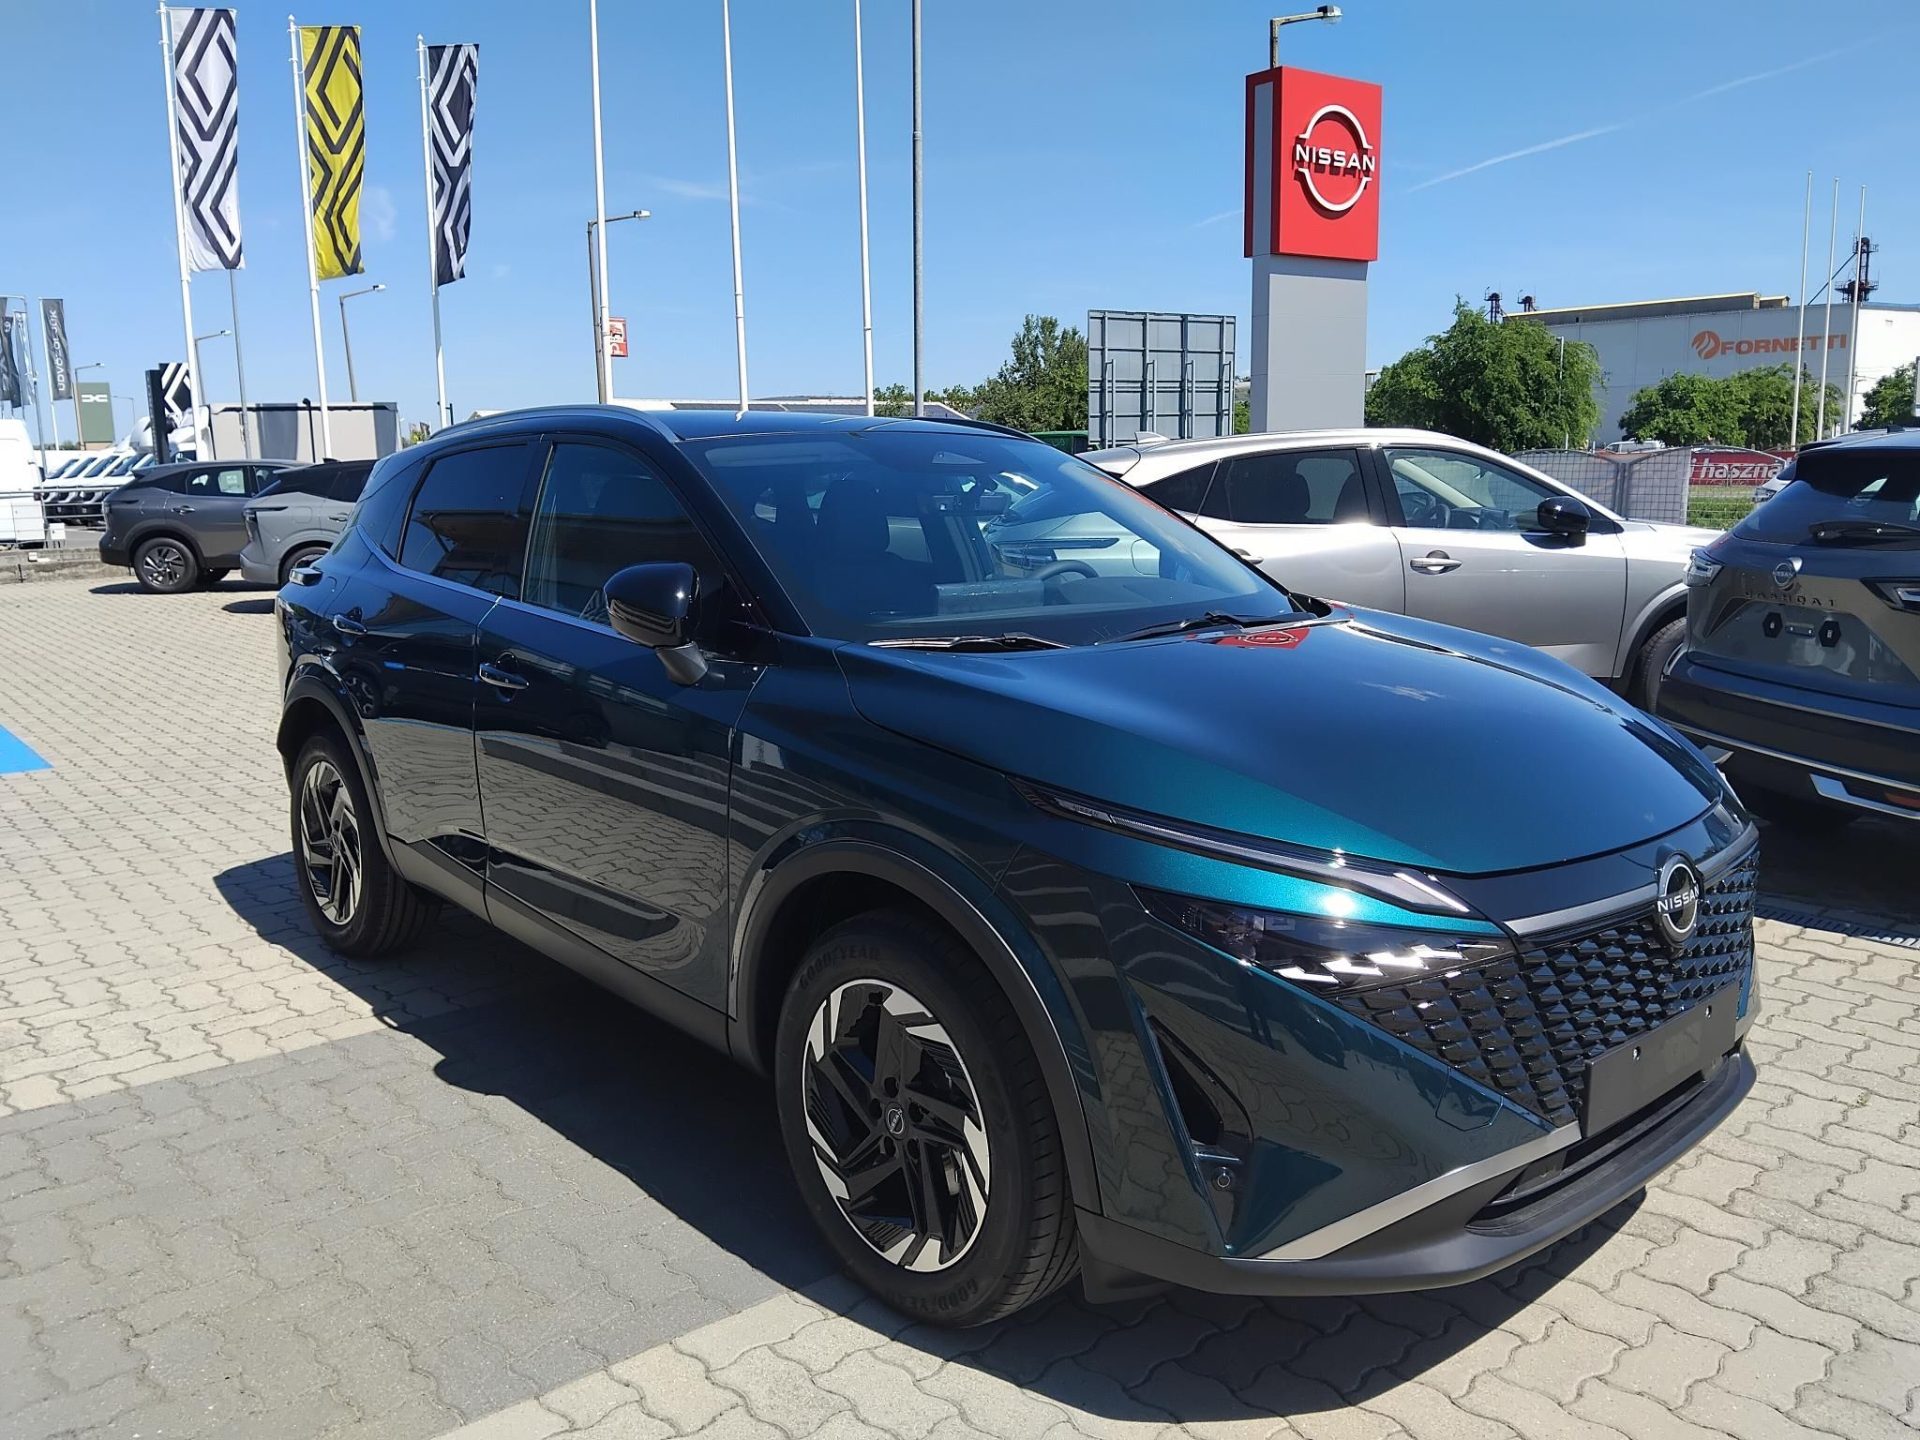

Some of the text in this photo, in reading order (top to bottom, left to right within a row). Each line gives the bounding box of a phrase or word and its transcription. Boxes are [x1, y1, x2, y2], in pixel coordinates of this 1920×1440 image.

[1295, 144, 1376, 172] NISSAN
[1720, 333, 1848, 355] FORNETTI
[1657, 884, 1700, 912] NISSAN
